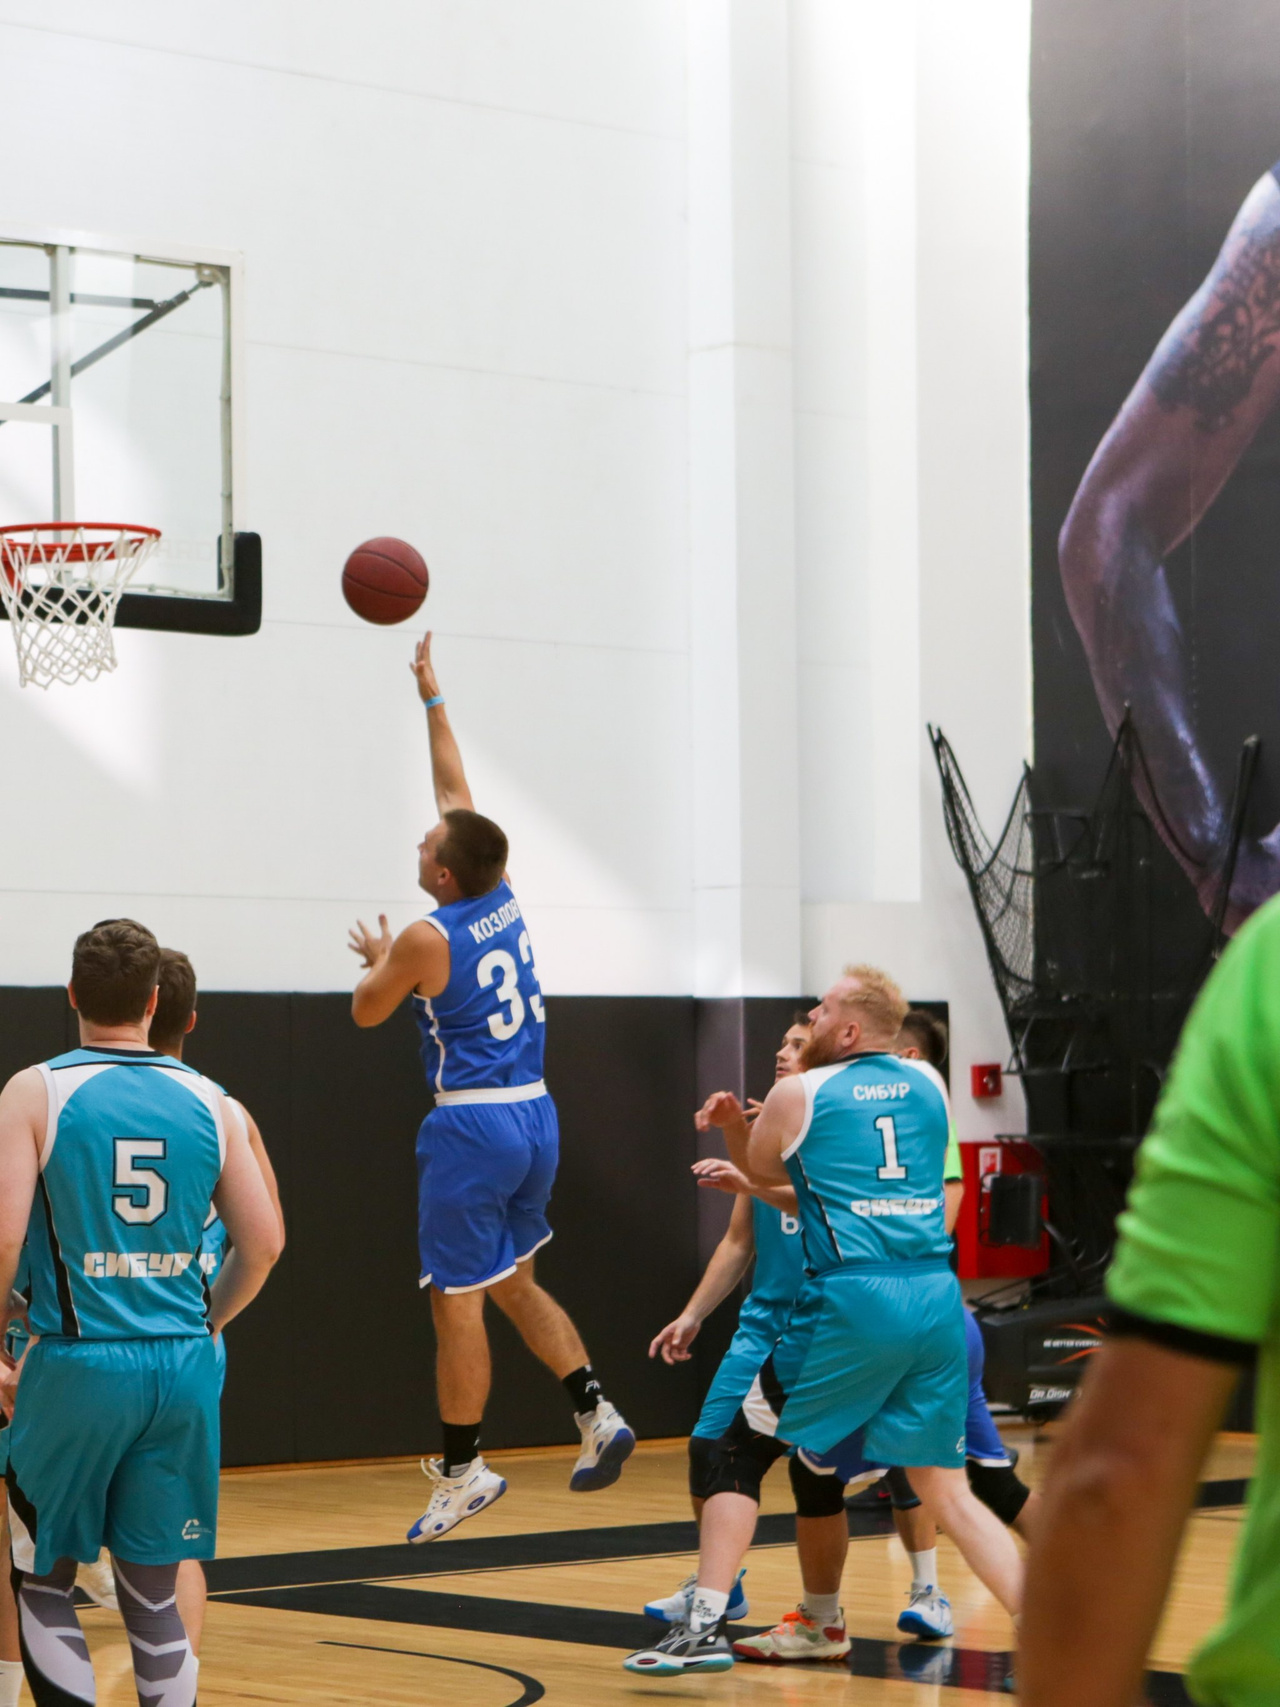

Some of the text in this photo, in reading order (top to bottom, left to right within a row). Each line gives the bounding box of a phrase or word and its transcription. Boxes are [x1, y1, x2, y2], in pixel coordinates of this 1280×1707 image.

[852, 1082, 910, 1101] СИБУР
[874, 1115, 908, 1181] 1
[112, 1137, 169, 1227] 5
[83, 1252, 193, 1278] СИБУР
